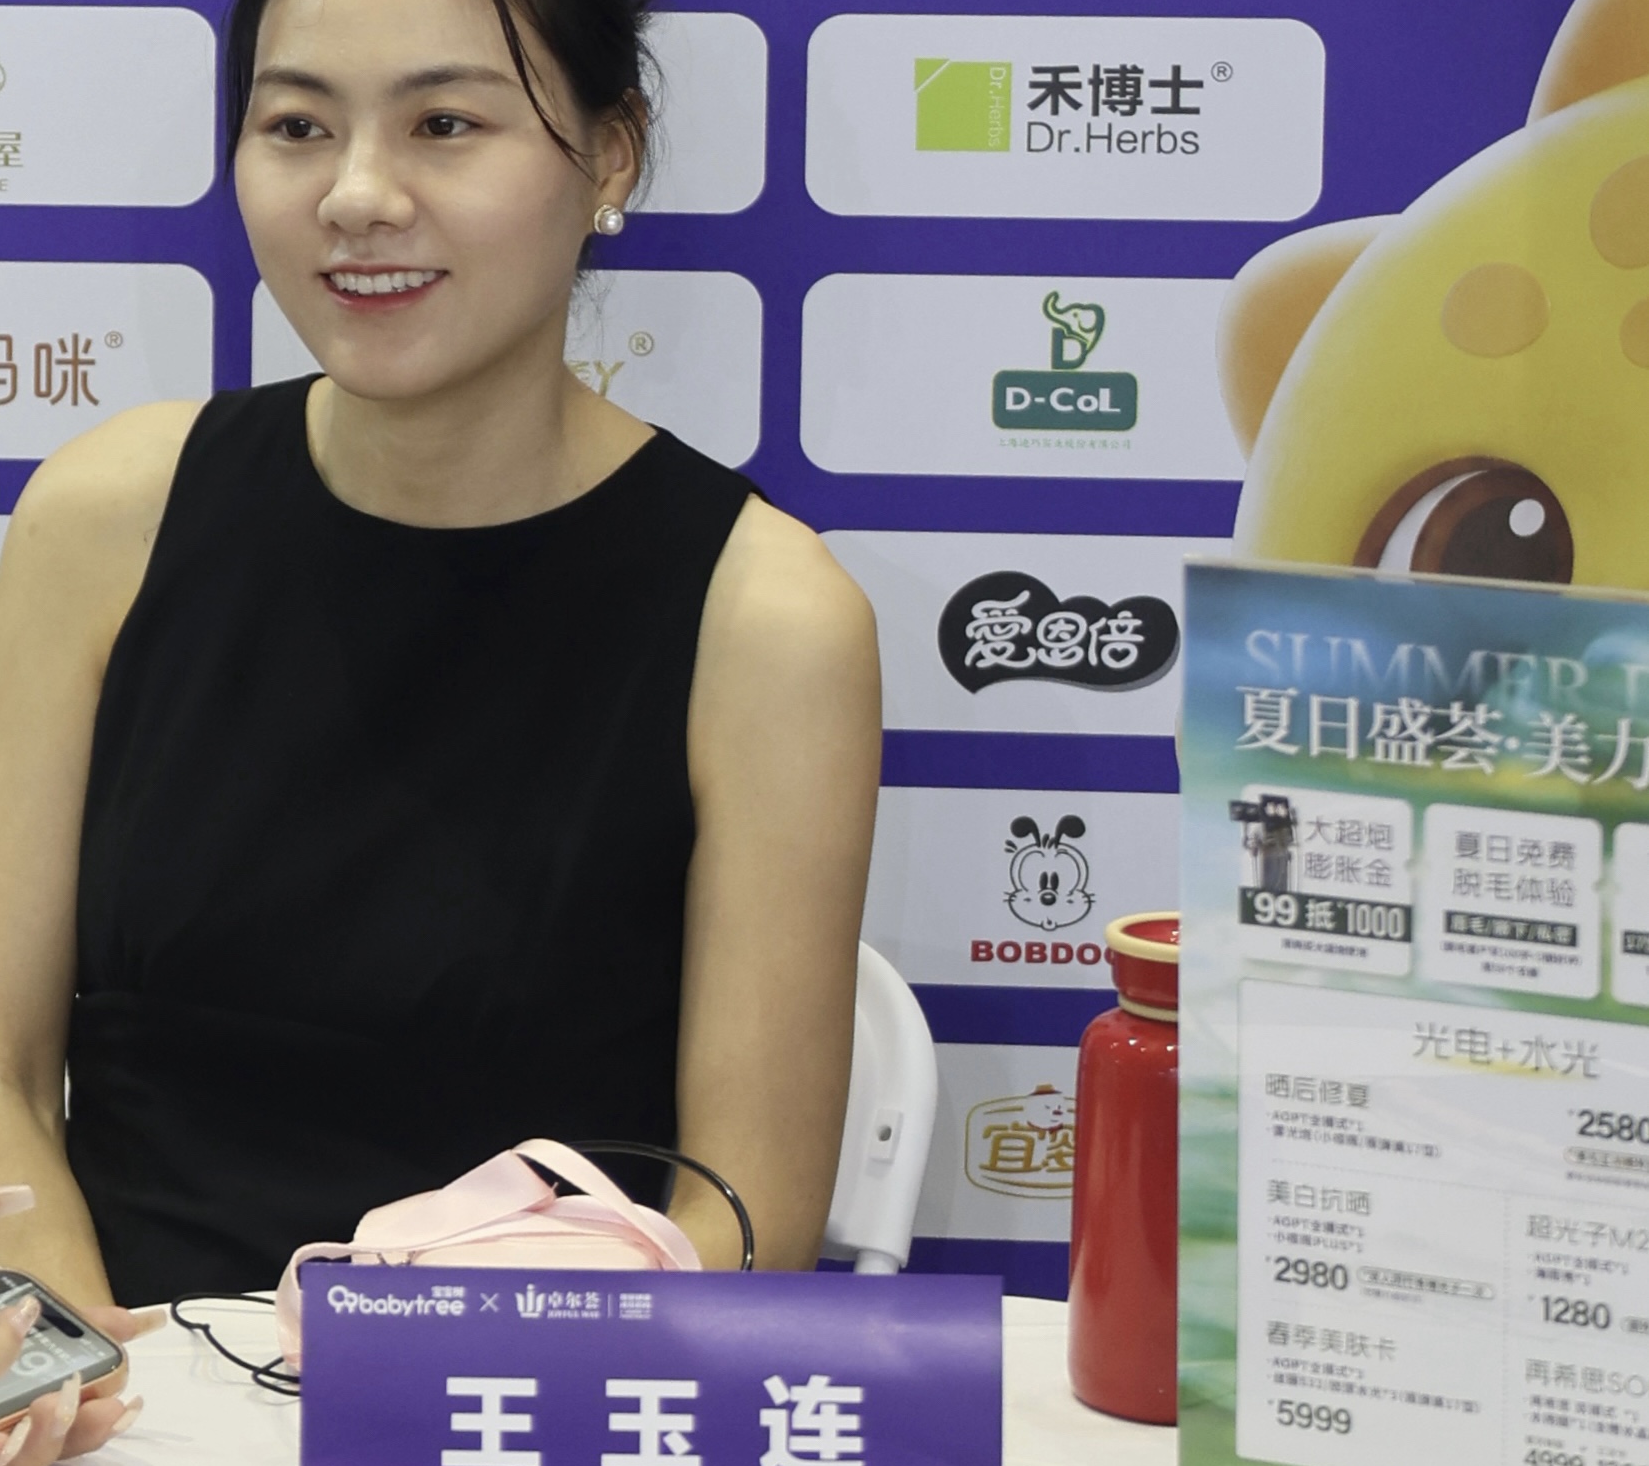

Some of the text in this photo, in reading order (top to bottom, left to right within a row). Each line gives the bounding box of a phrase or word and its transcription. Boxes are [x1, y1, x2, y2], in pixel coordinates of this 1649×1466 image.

[1028, 65, 1203, 116] 禾博士
[1027, 122, 1199, 154] Dr.Herbs
[1453, 867, 1575, 908] 脱毛体验
[1412, 1021, 1601, 1079] 光电+水光
[1267, 1180, 1371, 1216] 美白抗晒
[1273, 1256, 1349, 1291] 2980
[359, 1292, 465, 1317] babytree
[1541, 1295, 1611, 1330] 1280
[1267, 1320, 1397, 1362] 春季美肤卡
[1277, 1399, 1352, 1435] 5999
